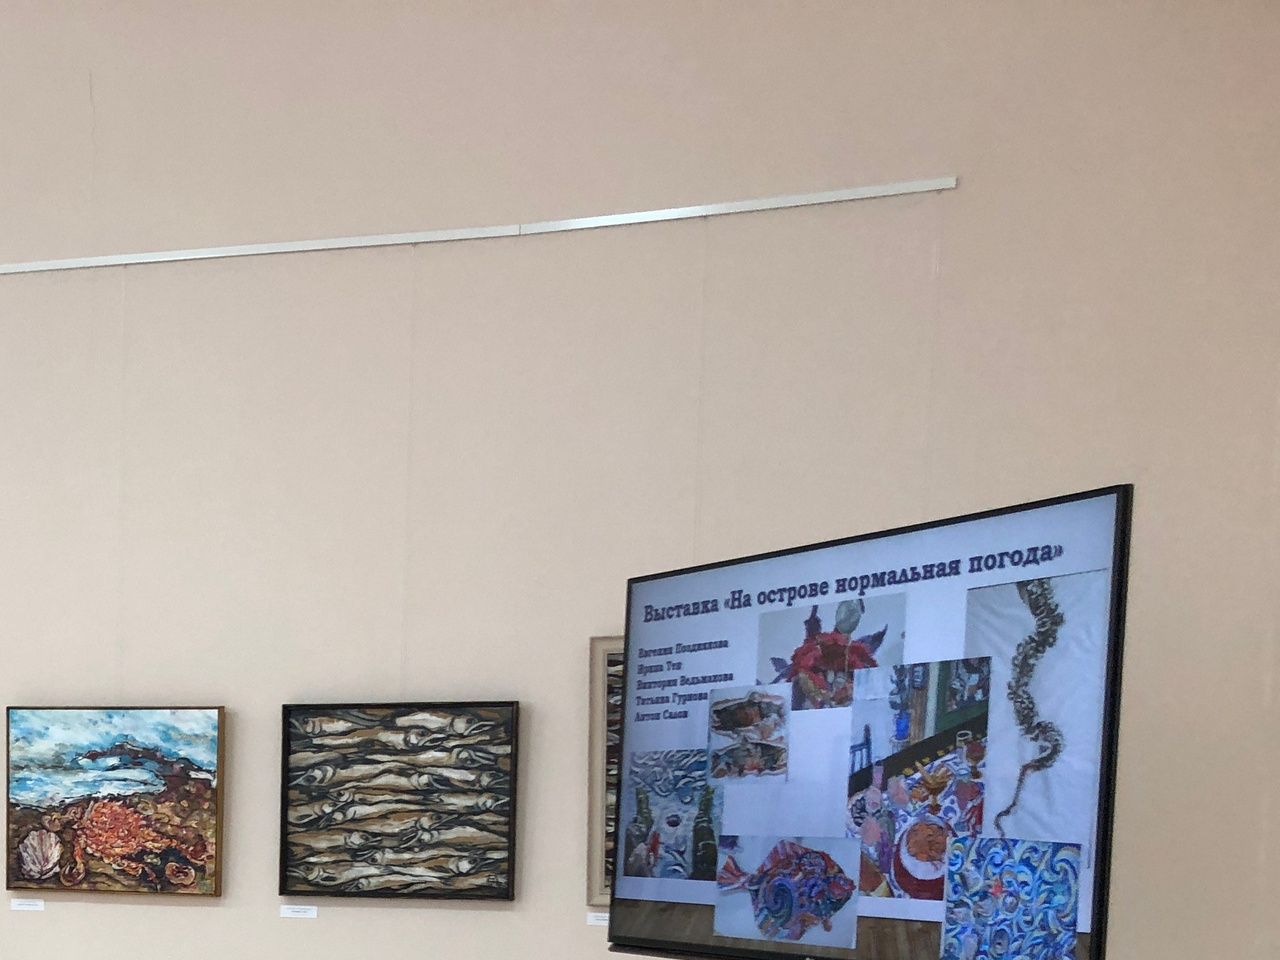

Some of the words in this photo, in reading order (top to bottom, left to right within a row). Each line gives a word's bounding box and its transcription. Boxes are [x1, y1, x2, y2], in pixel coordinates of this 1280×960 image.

[643, 598, 720, 623] Выставка
[723, 589, 753, 611] «На
[756, 580, 829, 607] острове
[835, 559, 961, 596] нормальная
[967, 544, 1063, 574] погода»
